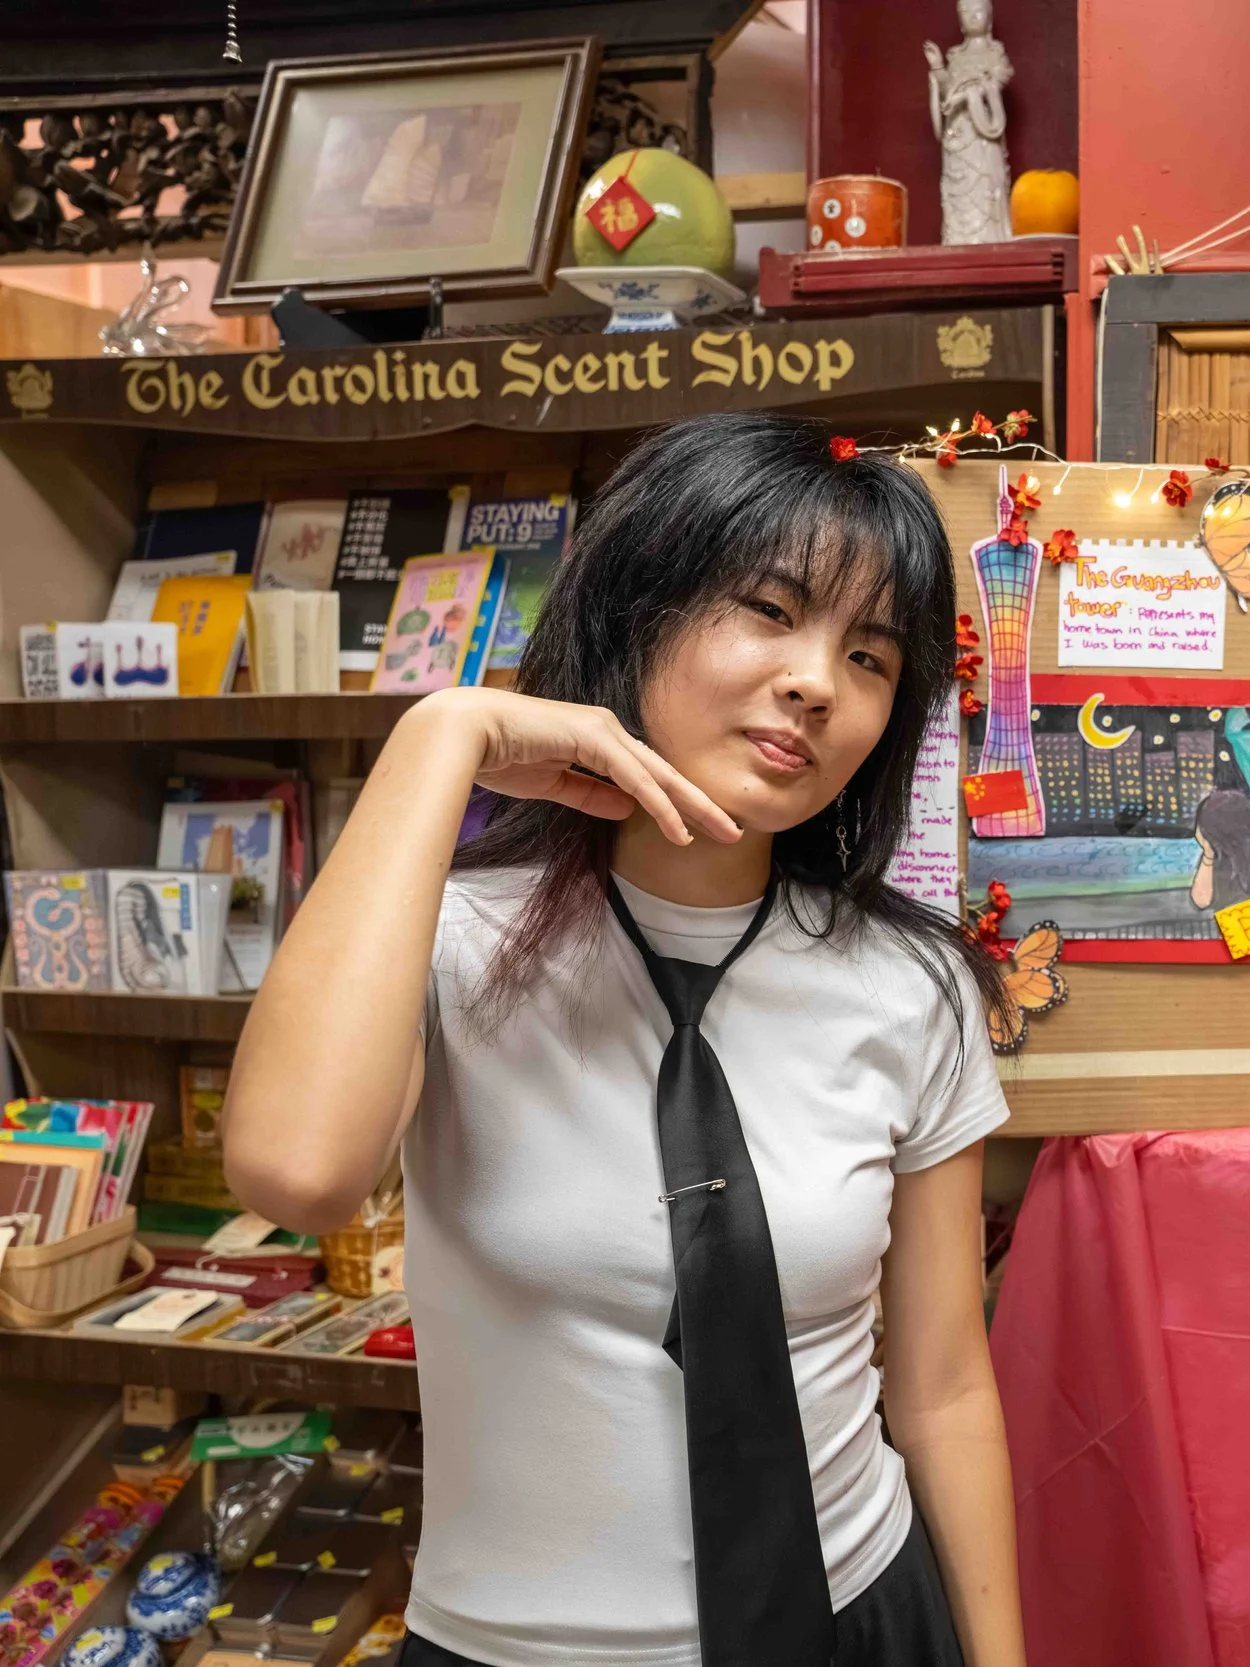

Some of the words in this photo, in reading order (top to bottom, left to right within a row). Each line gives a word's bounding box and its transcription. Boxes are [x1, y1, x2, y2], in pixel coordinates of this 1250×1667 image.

[120, 358, 229, 417] The
[242, 350, 481, 410] Carolina
[500, 341, 670, 398] Scent
[691, 330, 855, 391] Shop
[471, 501, 559, 525] STAYING
[1074, 556, 1109, 589] The
[1111, 566, 1220, 601] Guangzhou
[1065, 639, 1073, 648] I
[921, 815, 952, 825] made
